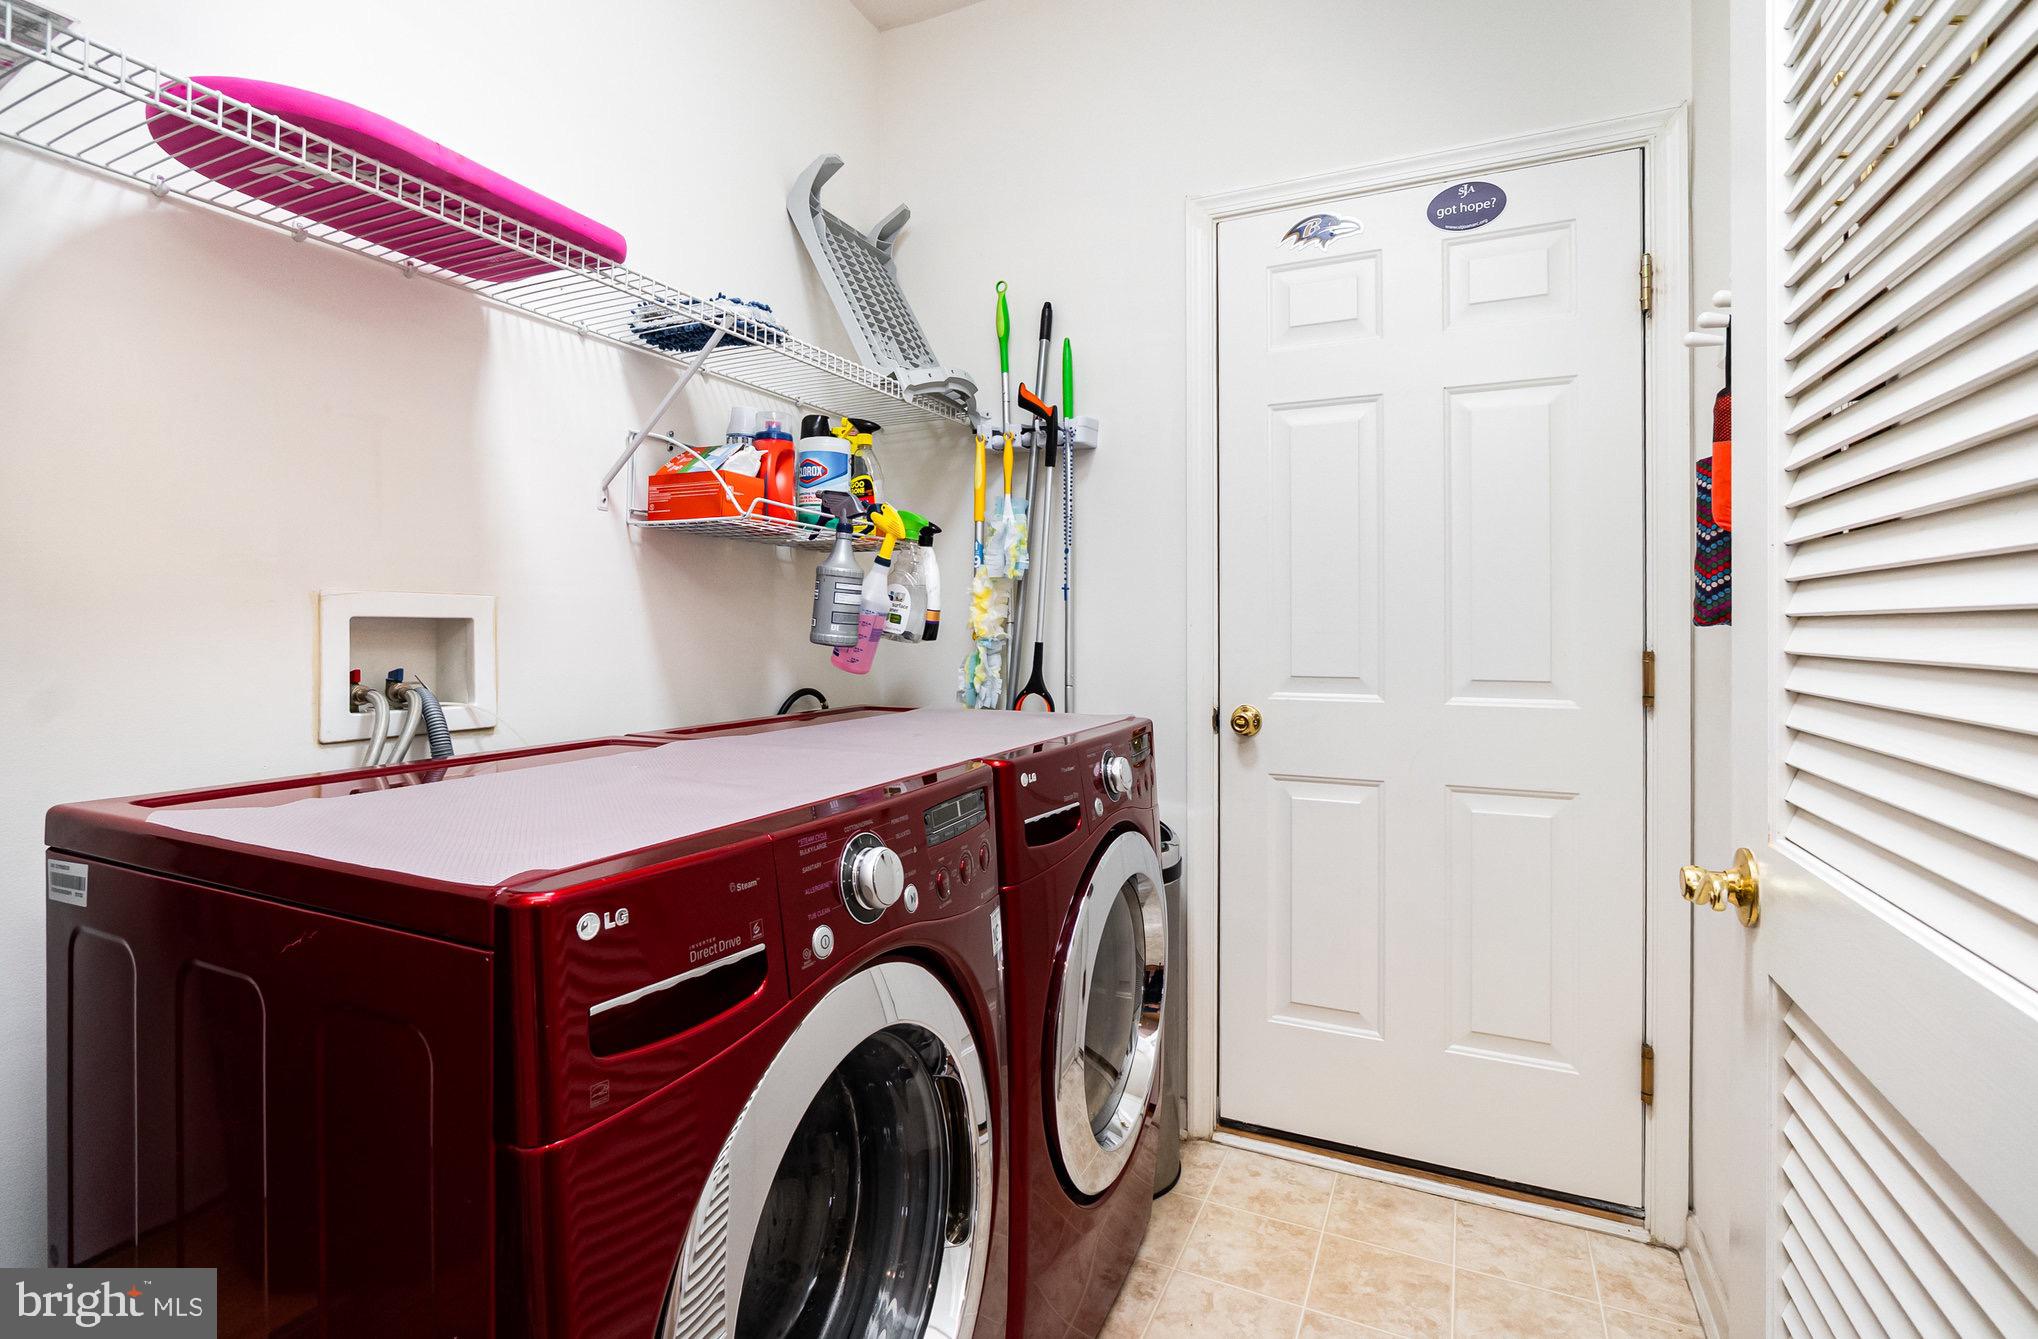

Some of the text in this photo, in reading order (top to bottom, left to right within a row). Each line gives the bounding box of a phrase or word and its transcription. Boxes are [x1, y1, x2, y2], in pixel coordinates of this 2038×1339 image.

[1436, 197, 1497, 219] got hope?
[800, 466, 822, 477] LOROX
[1028, 773, 1037, 783] LG
[603, 907, 630, 930] LG
[688, 936, 716, 951] INVERTER
[689, 935, 742, 963] Direct Drive
